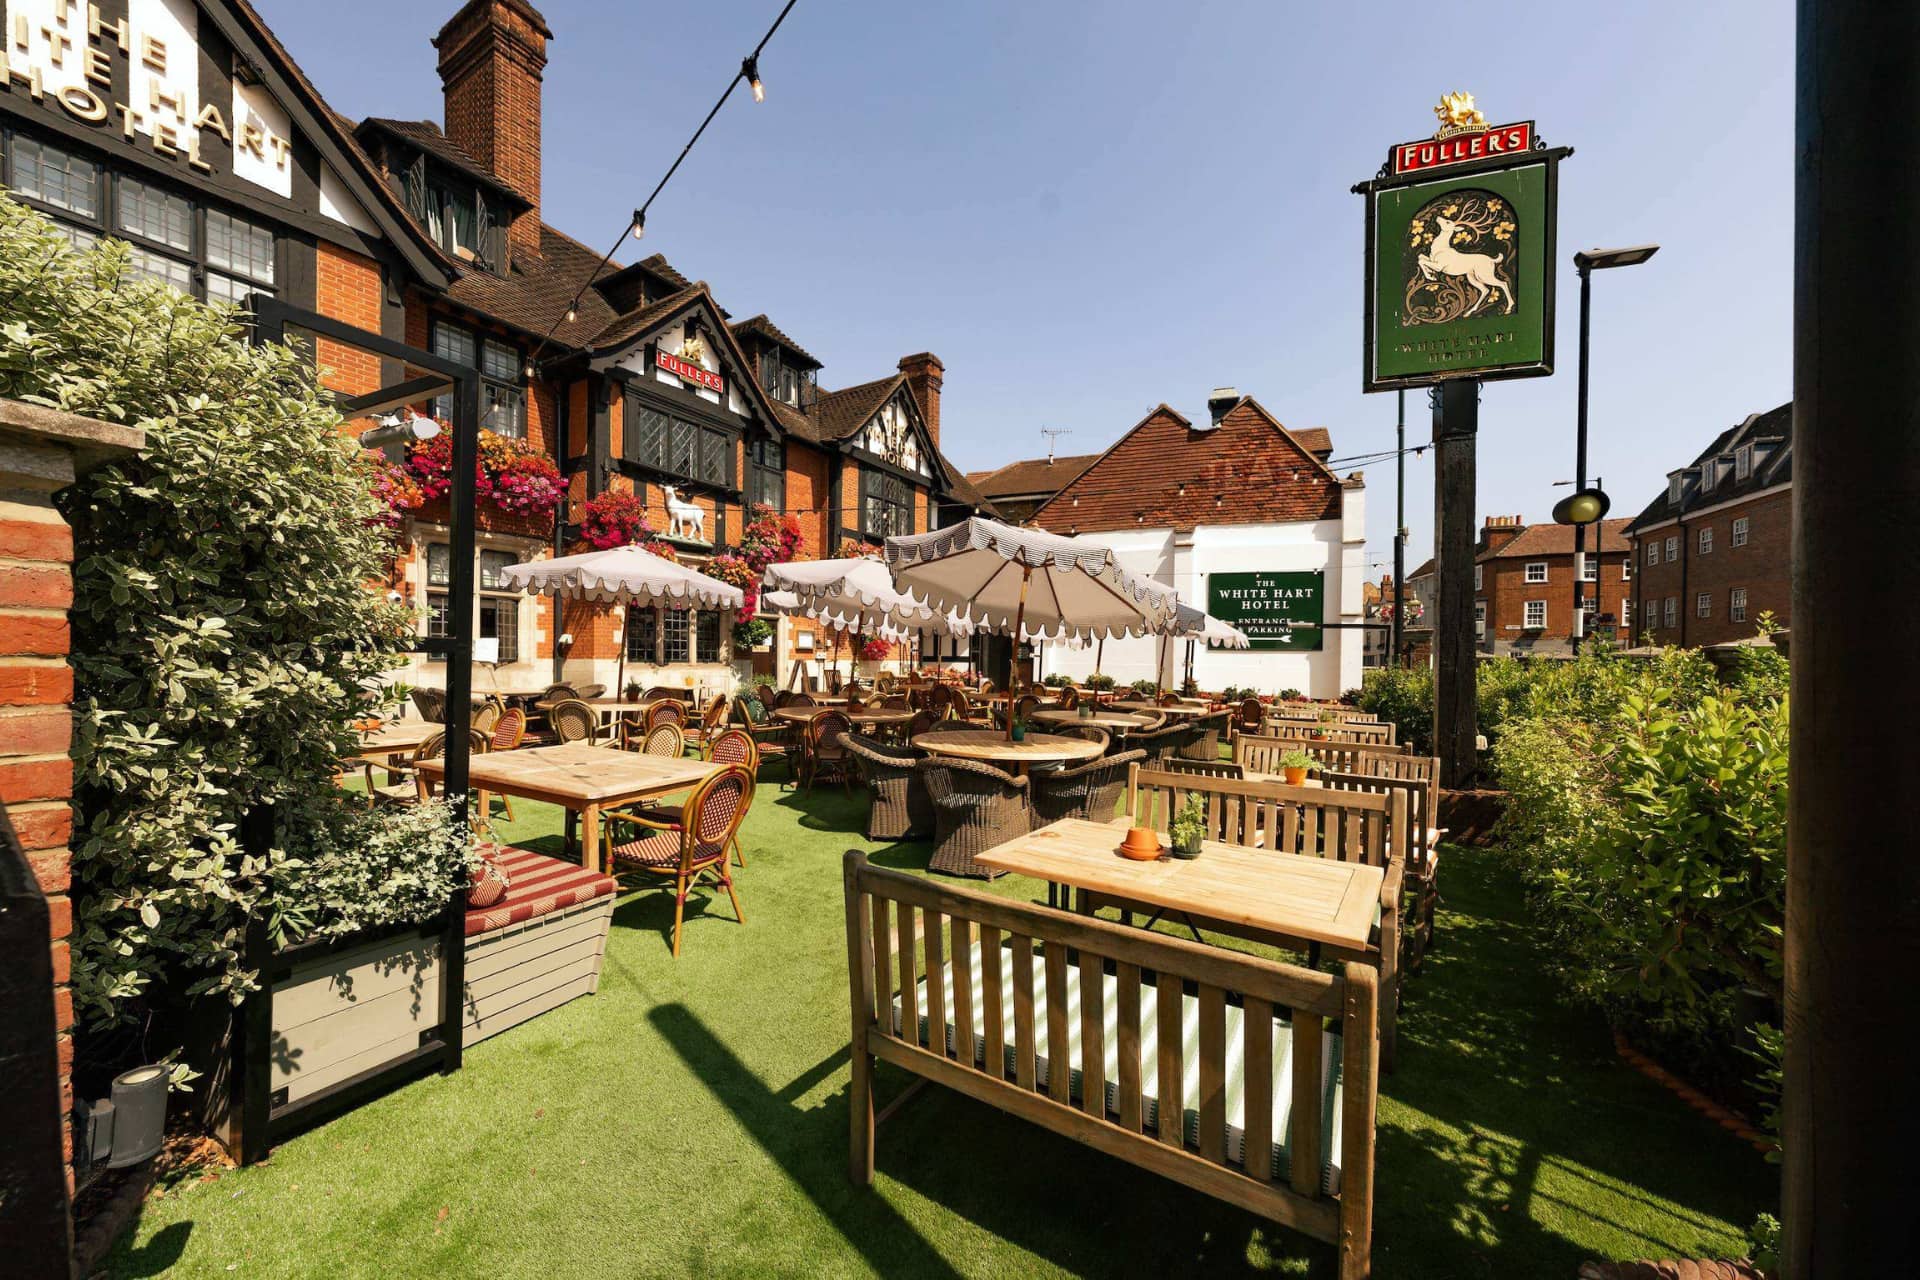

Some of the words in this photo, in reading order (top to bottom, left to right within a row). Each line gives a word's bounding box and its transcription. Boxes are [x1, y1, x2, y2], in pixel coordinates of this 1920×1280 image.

[15, 15, 112, 86] ITE
[150, 77, 292, 167] HART
[0, 50, 212, 171] HOTEL
[1404, 130, 1521, 167] FULLER'S
[879, 448, 911, 472] HOTEL
[1219, 589, 1268, 599] WHITE
[1274, 588, 1314, 598] HART
[1241, 600, 1290, 610] HOTEL
